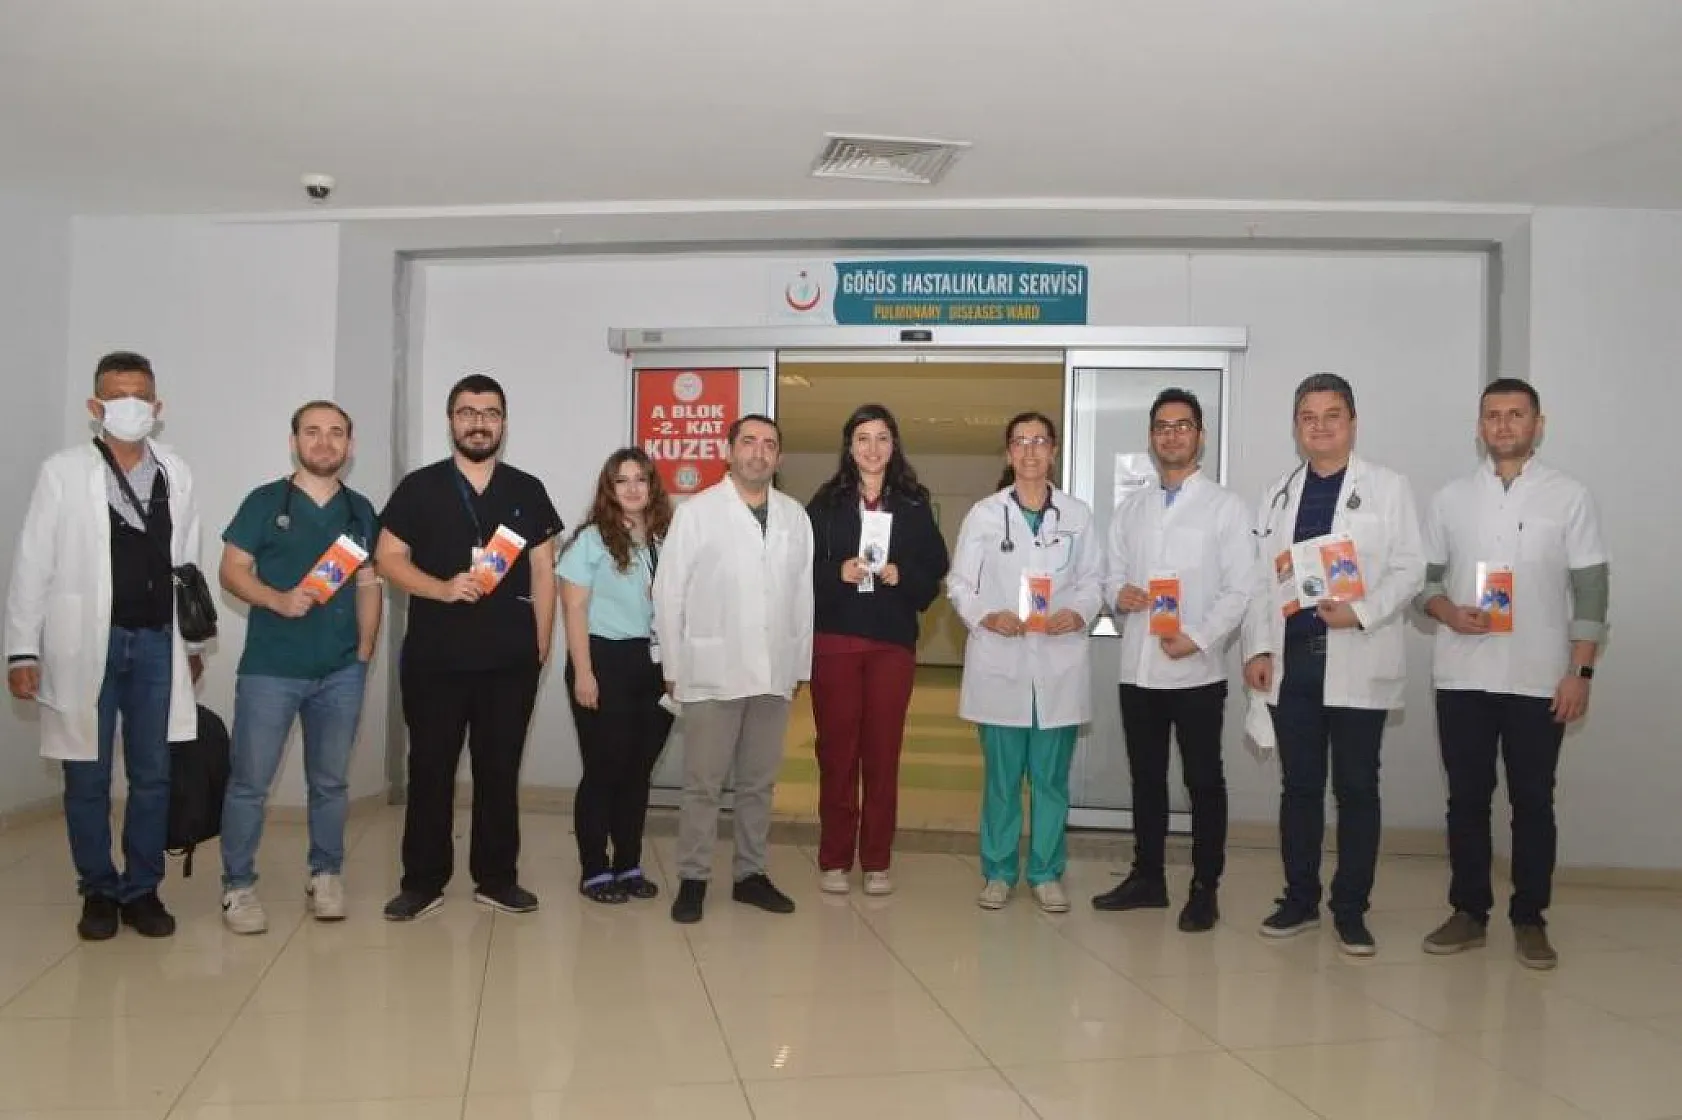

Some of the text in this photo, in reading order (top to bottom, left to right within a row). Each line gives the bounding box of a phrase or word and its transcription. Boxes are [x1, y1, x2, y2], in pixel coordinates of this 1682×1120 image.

[842, 268, 1083, 295] GÖĞÜS HASTALIKLARI SERVİSİ
[651, 404, 725, 419] A BLOK
[652, 420, 724, 435] -2. KAT
[644, 438, 730, 460] KUZEY
